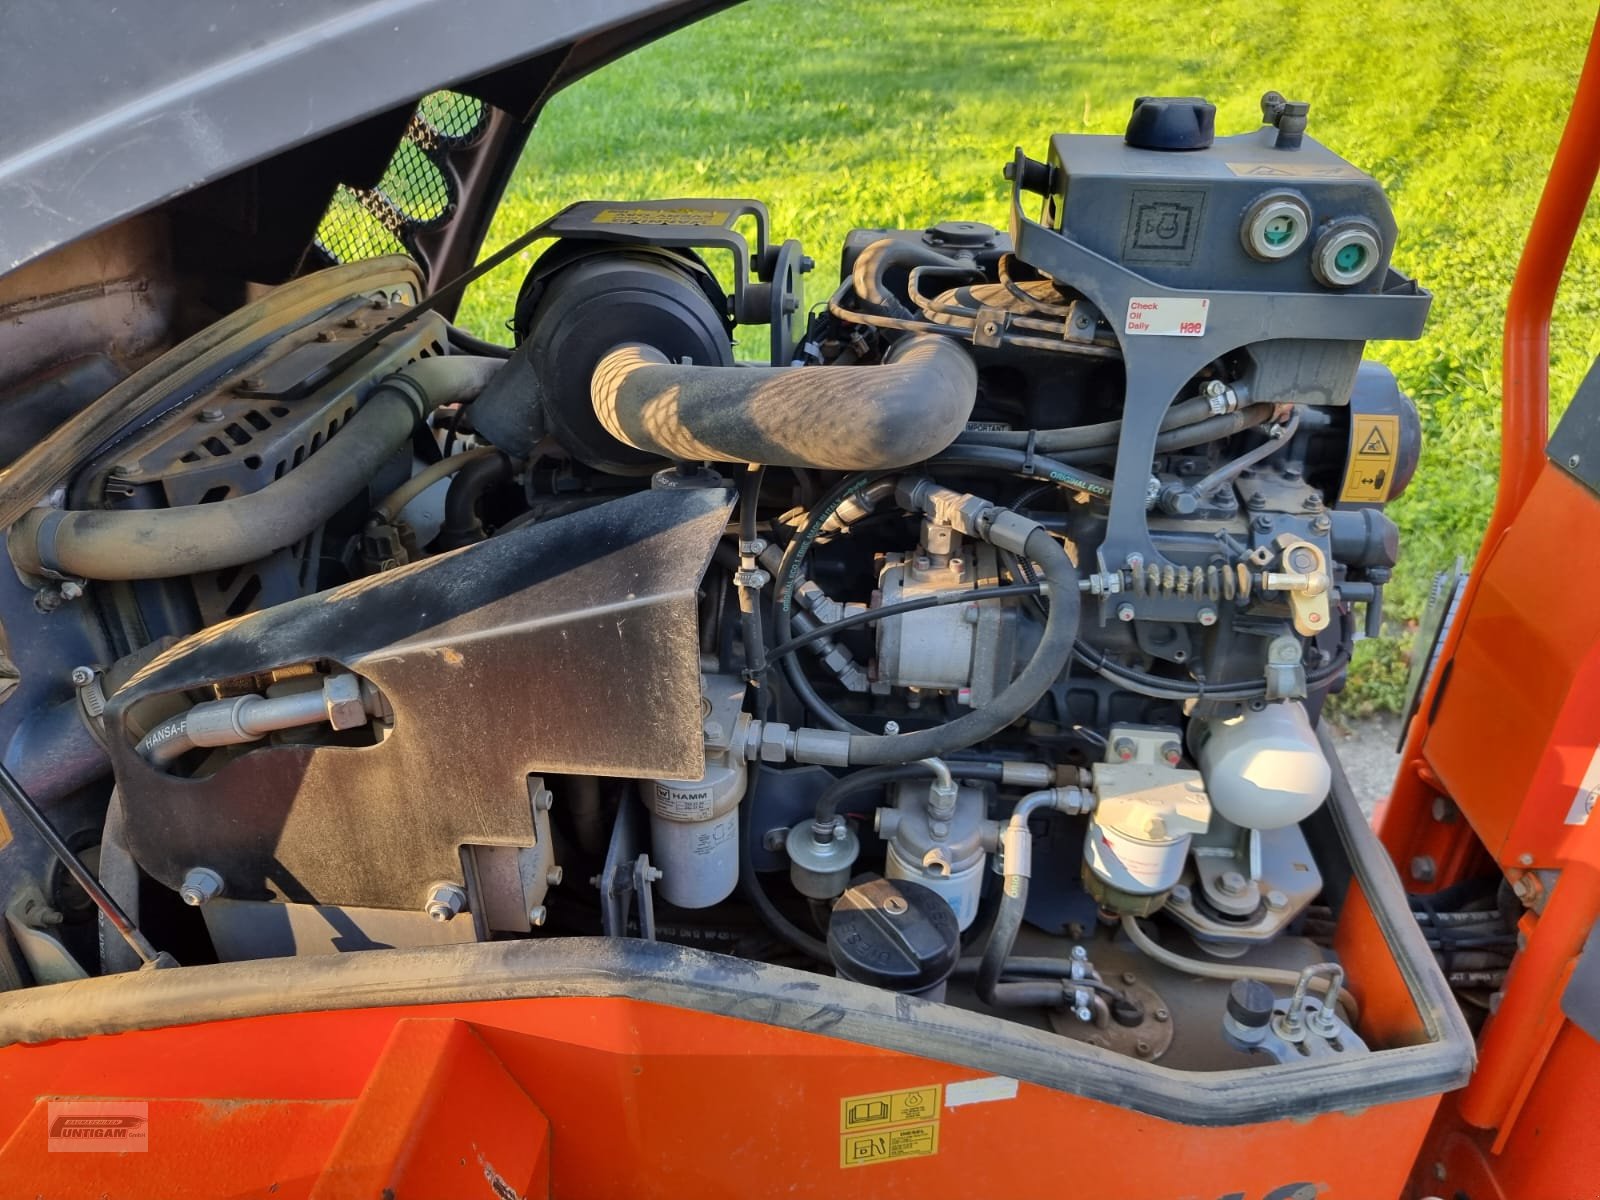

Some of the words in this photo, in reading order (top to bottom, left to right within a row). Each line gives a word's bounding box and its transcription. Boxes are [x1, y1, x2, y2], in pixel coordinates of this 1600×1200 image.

[1130, 302, 1158, 310] Check
[1128, 322, 1150, 331] Daily
[1050, 471, 1087, 489] ORIGINAL
[1088, 482, 1105, 494] ECO
[145, 720, 187, 750] HANSA-F
[672, 792, 707, 800] HAMM
